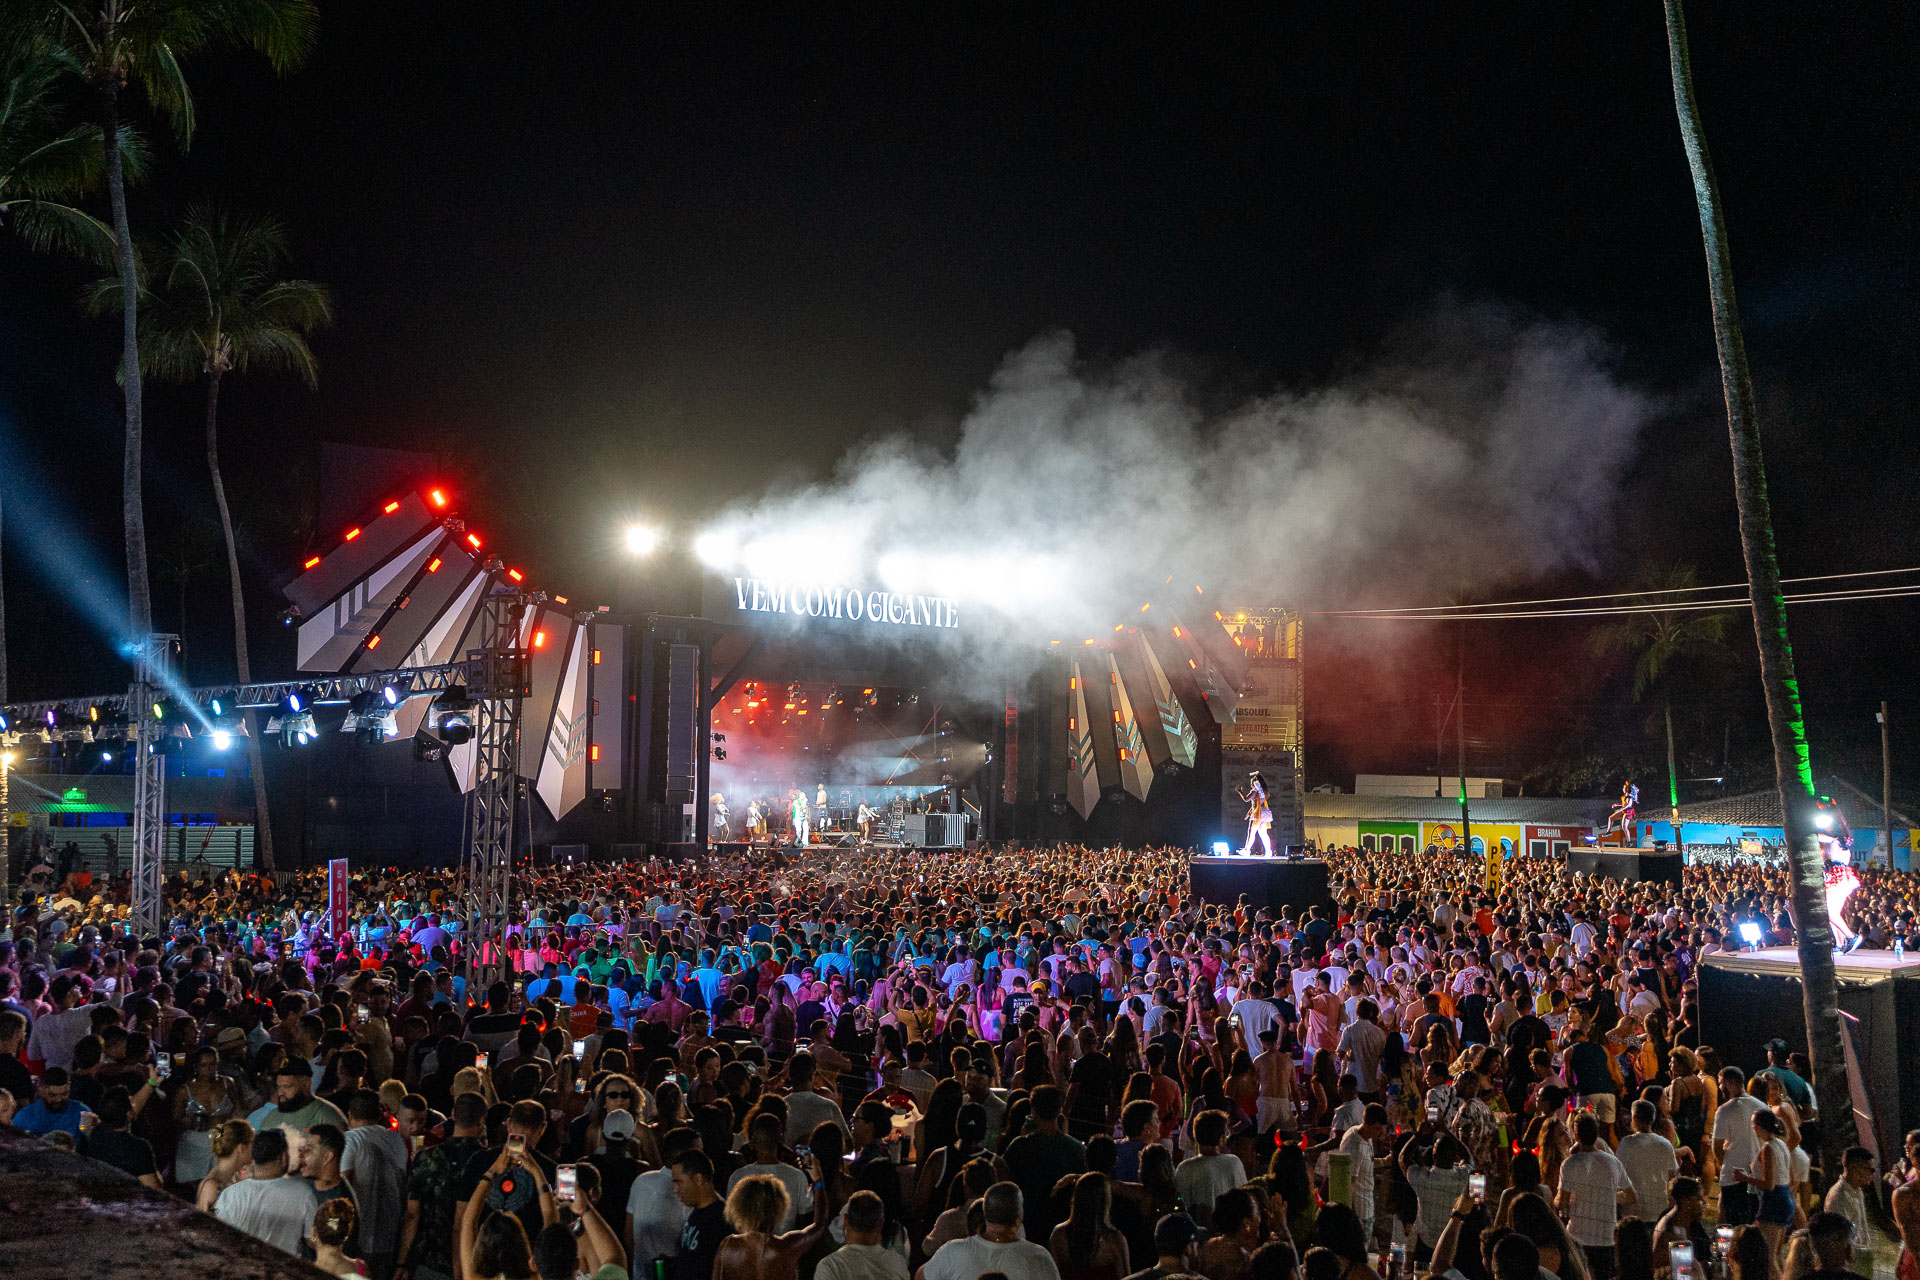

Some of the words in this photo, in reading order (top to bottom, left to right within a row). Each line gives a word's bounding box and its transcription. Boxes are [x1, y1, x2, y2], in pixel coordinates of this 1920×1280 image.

[735, 577, 786, 614] VEM
[791, 584, 842, 618] COM
[846, 588, 864, 621] O
[867, 591, 959, 628] GIGANTE
[1234, 723, 1269, 734] BEEFEATER
[1537, 828, 1561, 838] BRAHMA
[1490, 845, 1498, 892] PCD
